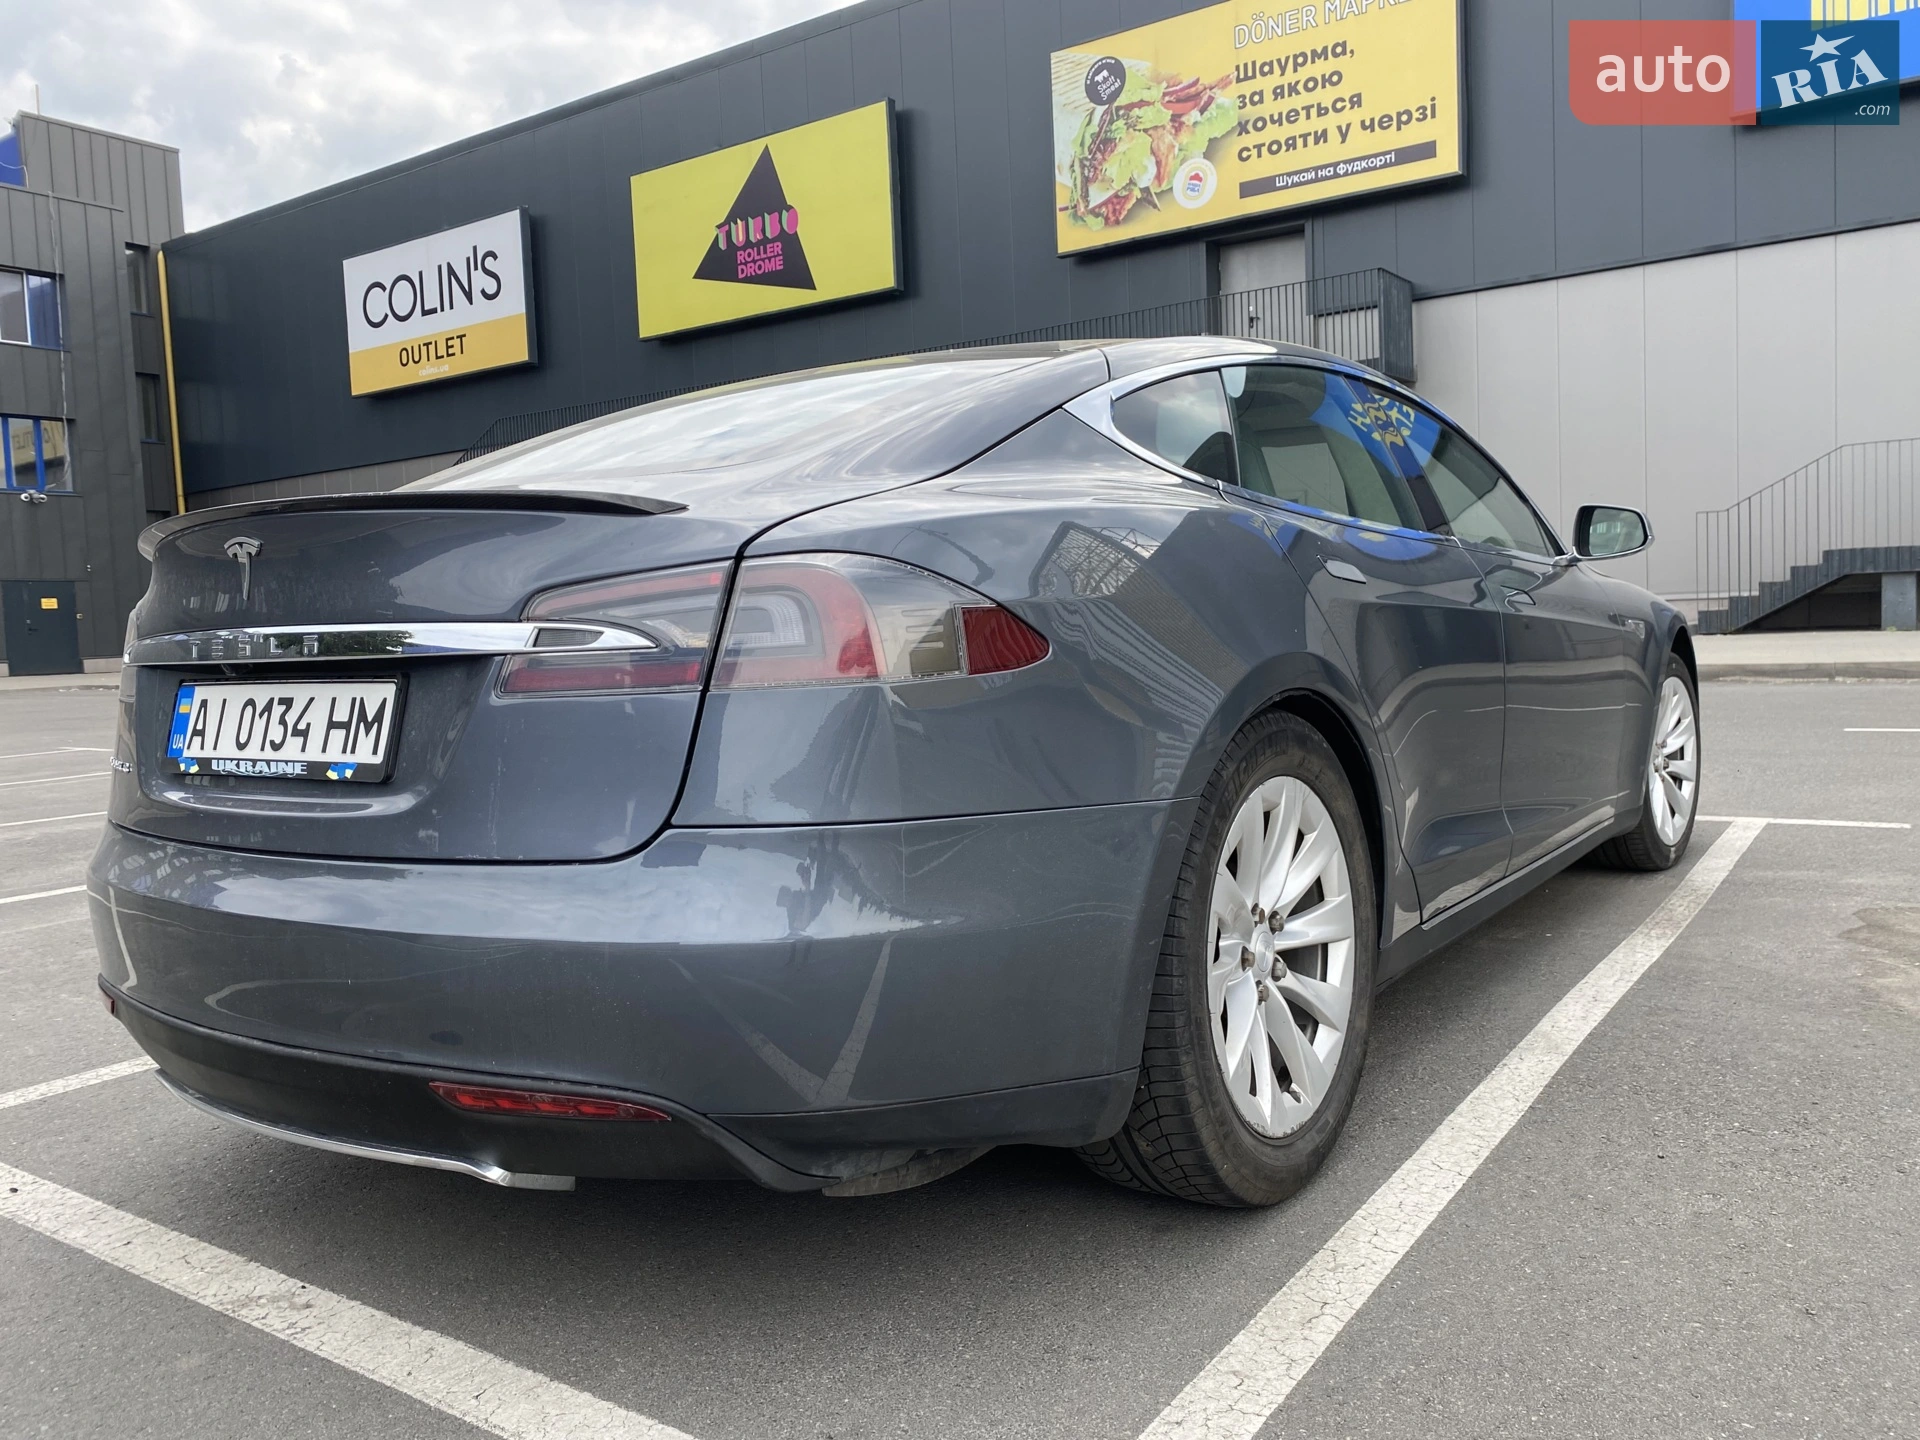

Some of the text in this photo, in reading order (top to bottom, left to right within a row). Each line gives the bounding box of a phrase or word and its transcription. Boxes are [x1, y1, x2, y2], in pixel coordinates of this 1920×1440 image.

[1234, 4, 1318, 49] DÖNER
[1235, 39, 1355, 84] Шаурма,
[1237, 70, 1343, 110] за якою
[1237, 92, 1363, 137] хочеться
[1237, 96, 1438, 163] стояти у черзі
[1275, 151, 1396, 188] Шукай на фудкорті
[714, 206, 799, 251] TURBO
[736, 241, 783, 264] ROLLER
[737, 255, 784, 279] DROME
[362, 244, 502, 329] COLIN'S
[398, 333, 467, 368] OUTLET
[189, 634, 319, 660] TESLA
[172, 733, 184, 750] UA
[186, 696, 388, 756] AI 0134 HM
[211, 758, 308, 777] UKRAINE
